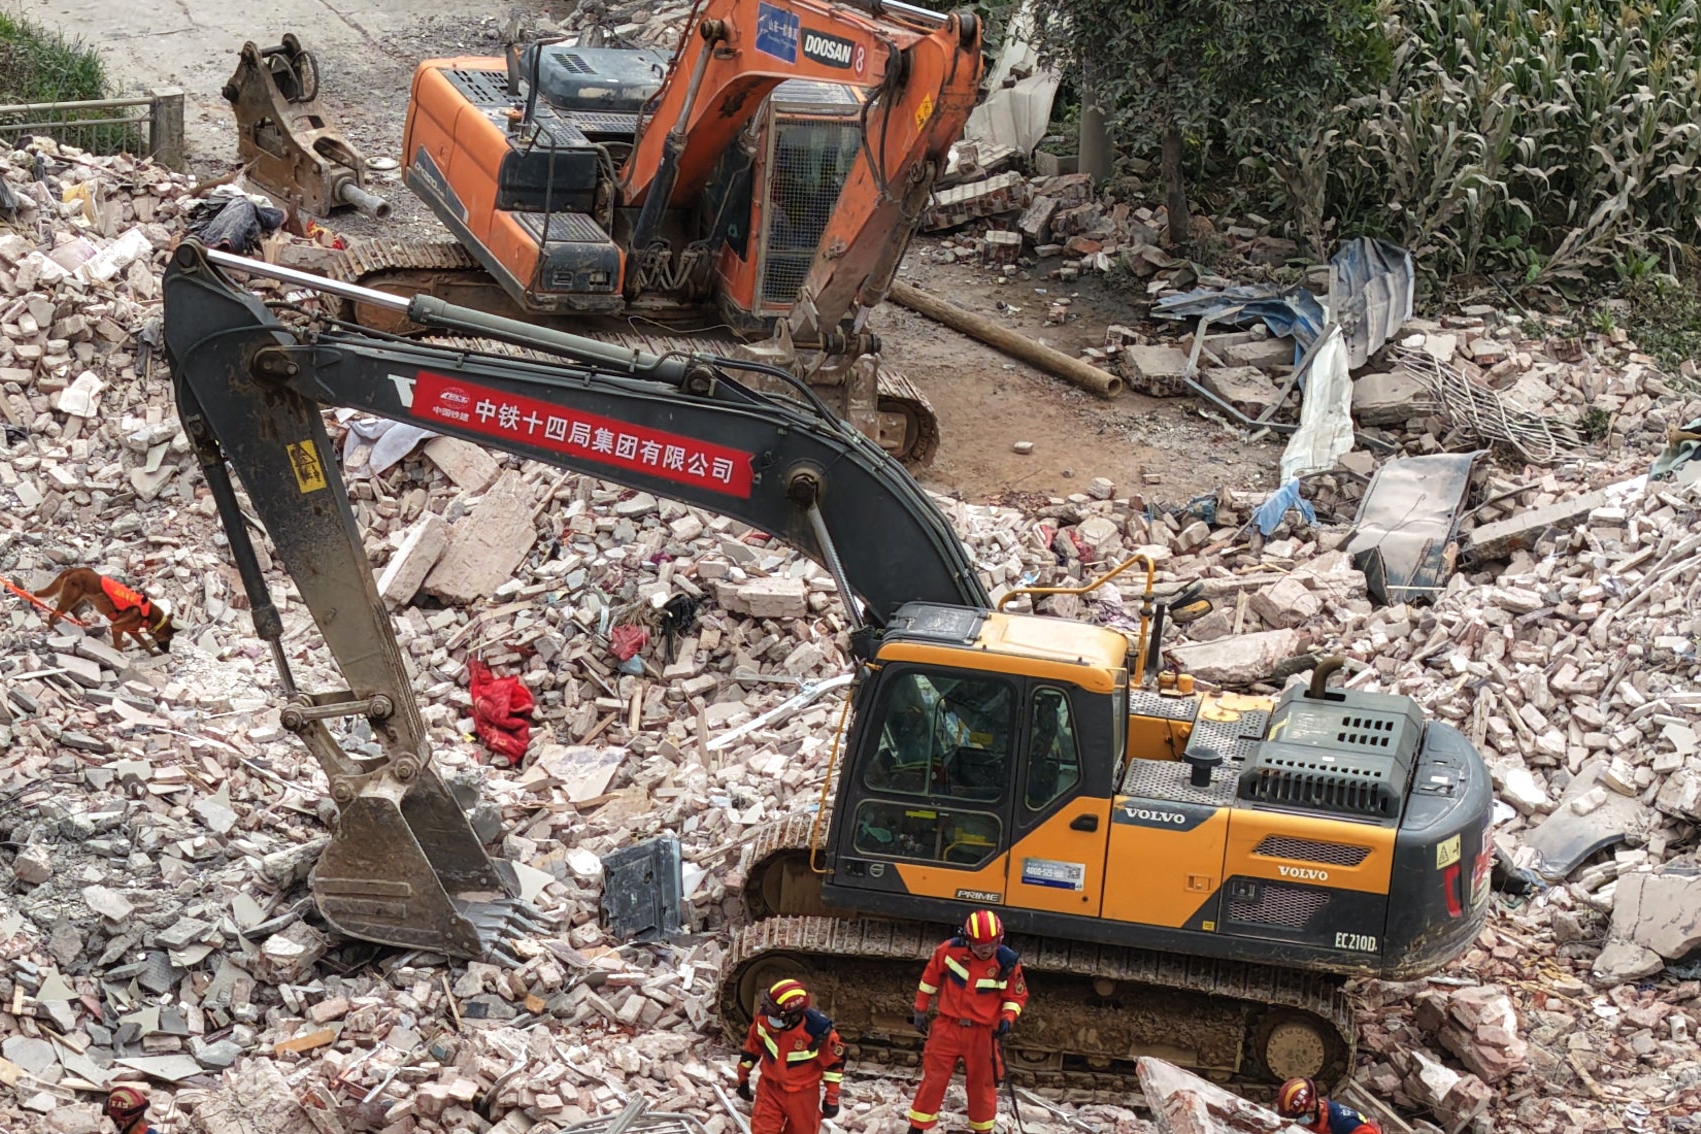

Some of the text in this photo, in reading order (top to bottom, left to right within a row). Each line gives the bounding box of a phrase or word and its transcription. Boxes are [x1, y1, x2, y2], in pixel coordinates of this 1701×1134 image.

[804, 34, 852, 64] DOOSAN
[855, 47, 865, 73] 8
[474, 398, 735, 485] 中铁十四局集团有限公司
[1125, 806, 1186, 825] VOLVO
[1277, 865, 1329, 882] VOLVO
[957, 890, 1000, 902] PRIME
